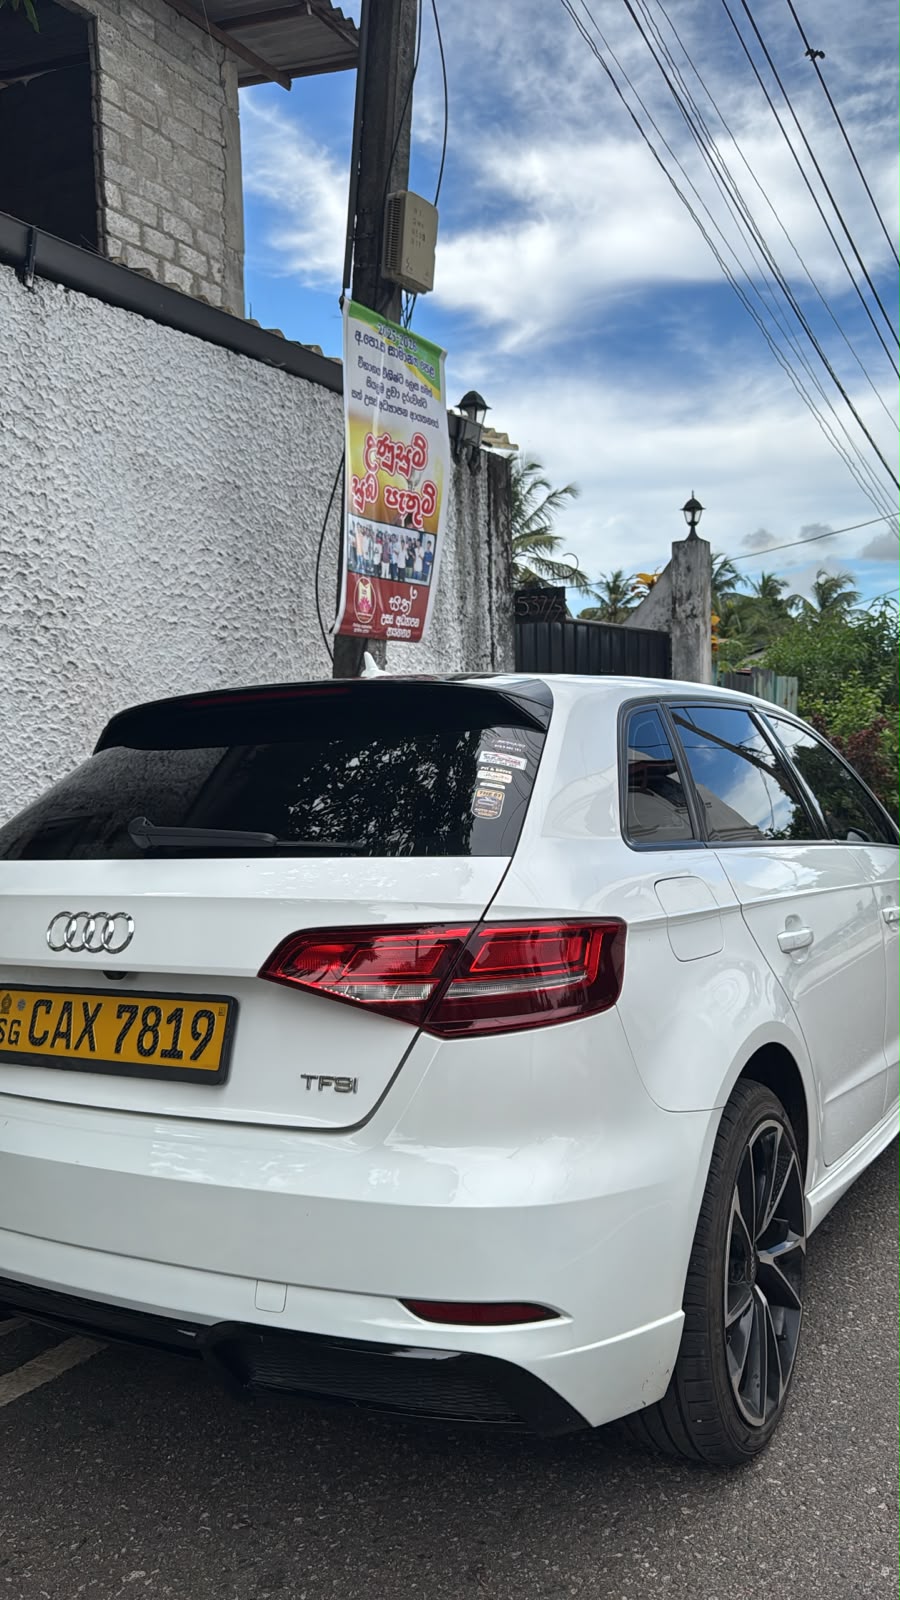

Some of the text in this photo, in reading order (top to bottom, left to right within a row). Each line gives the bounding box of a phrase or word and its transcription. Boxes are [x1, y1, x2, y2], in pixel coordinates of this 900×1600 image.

[364, 432, 428, 480] උණුසුම්
[383, 480, 438, 528] පැතුම්
[0, 999, 216, 1061] SG CAX 7819
[300, 1074, 358, 1094] TFSI
